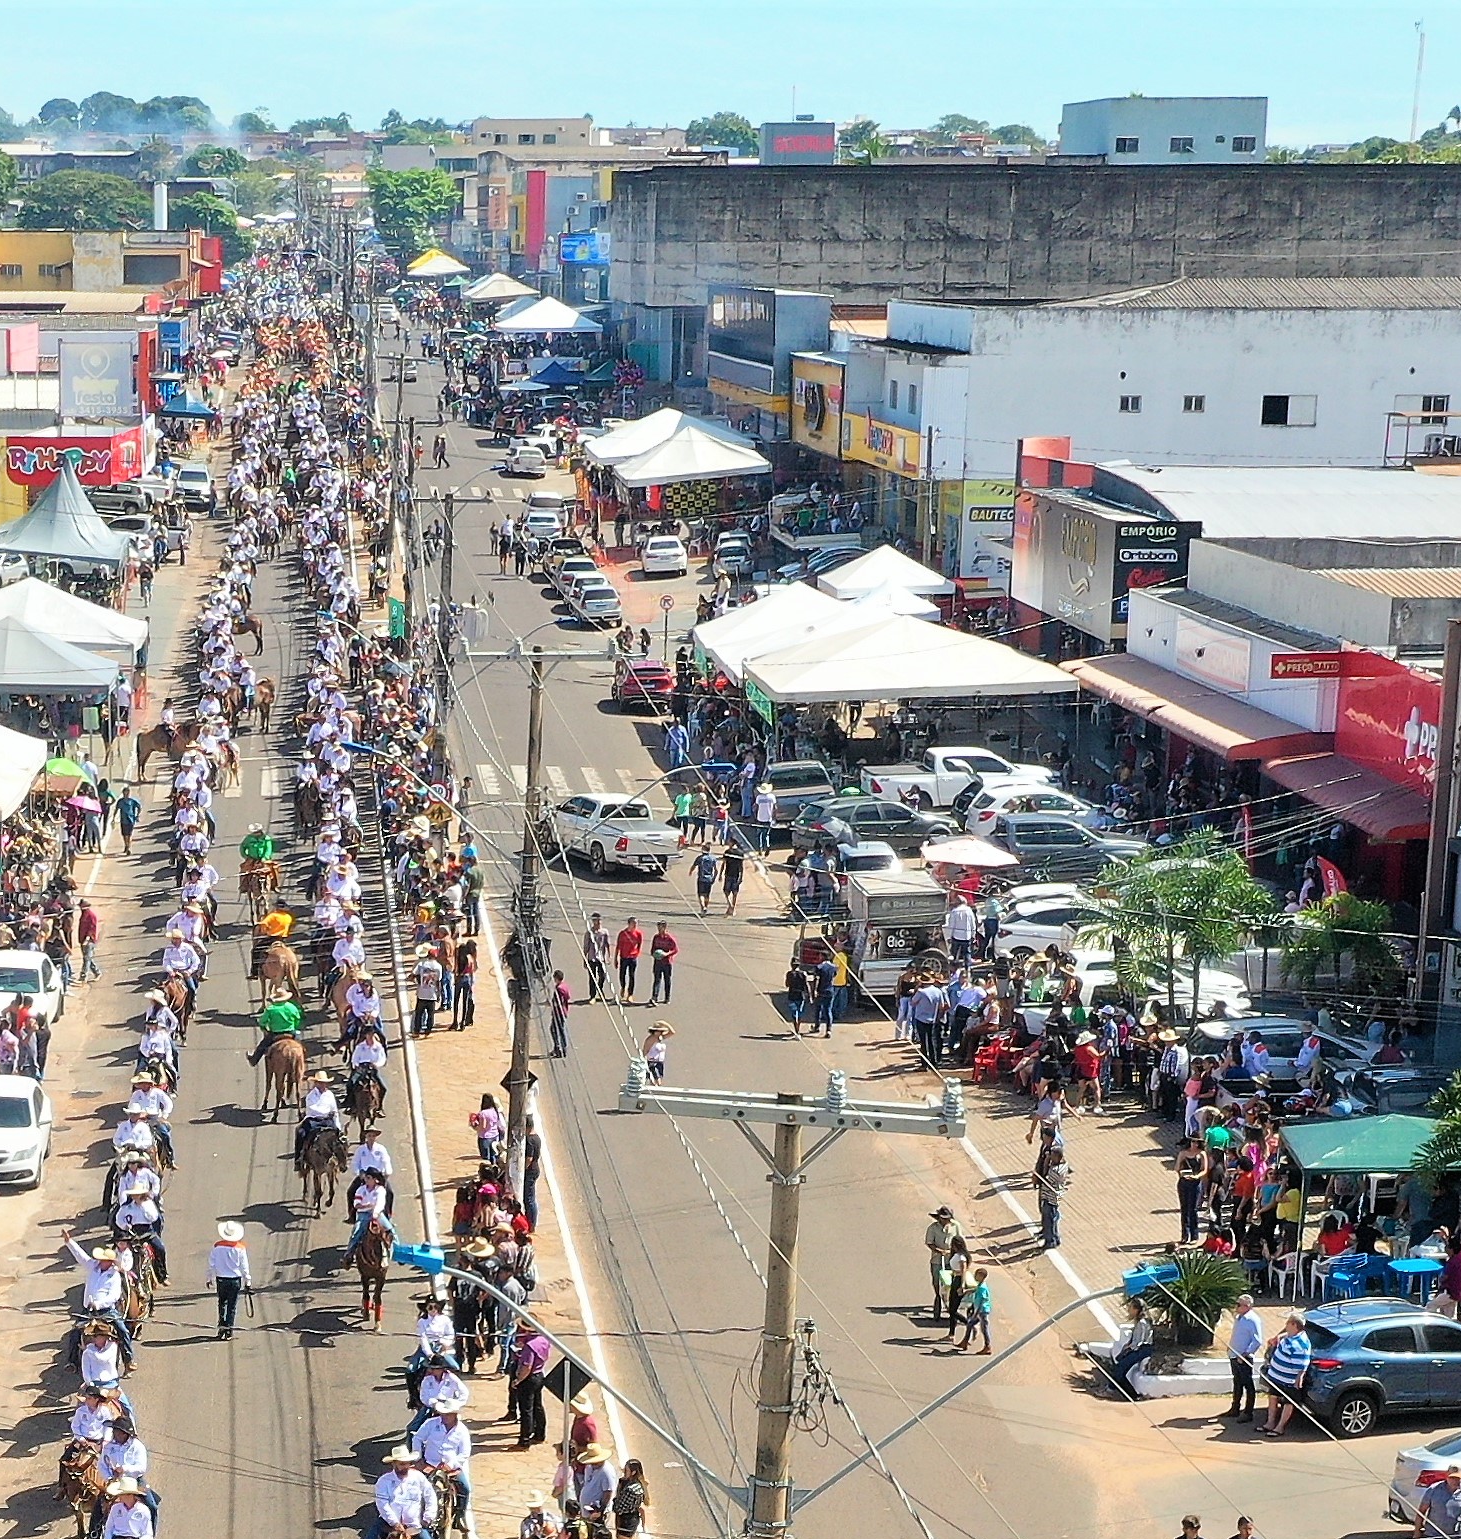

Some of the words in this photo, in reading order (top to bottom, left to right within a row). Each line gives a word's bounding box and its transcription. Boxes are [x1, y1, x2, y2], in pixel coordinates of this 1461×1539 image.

[1121, 525, 1177, 537] EMPÓRIO
[1121, 550, 1177, 561] Ortobom
[1286, 662, 1313, 673] PREÇO
